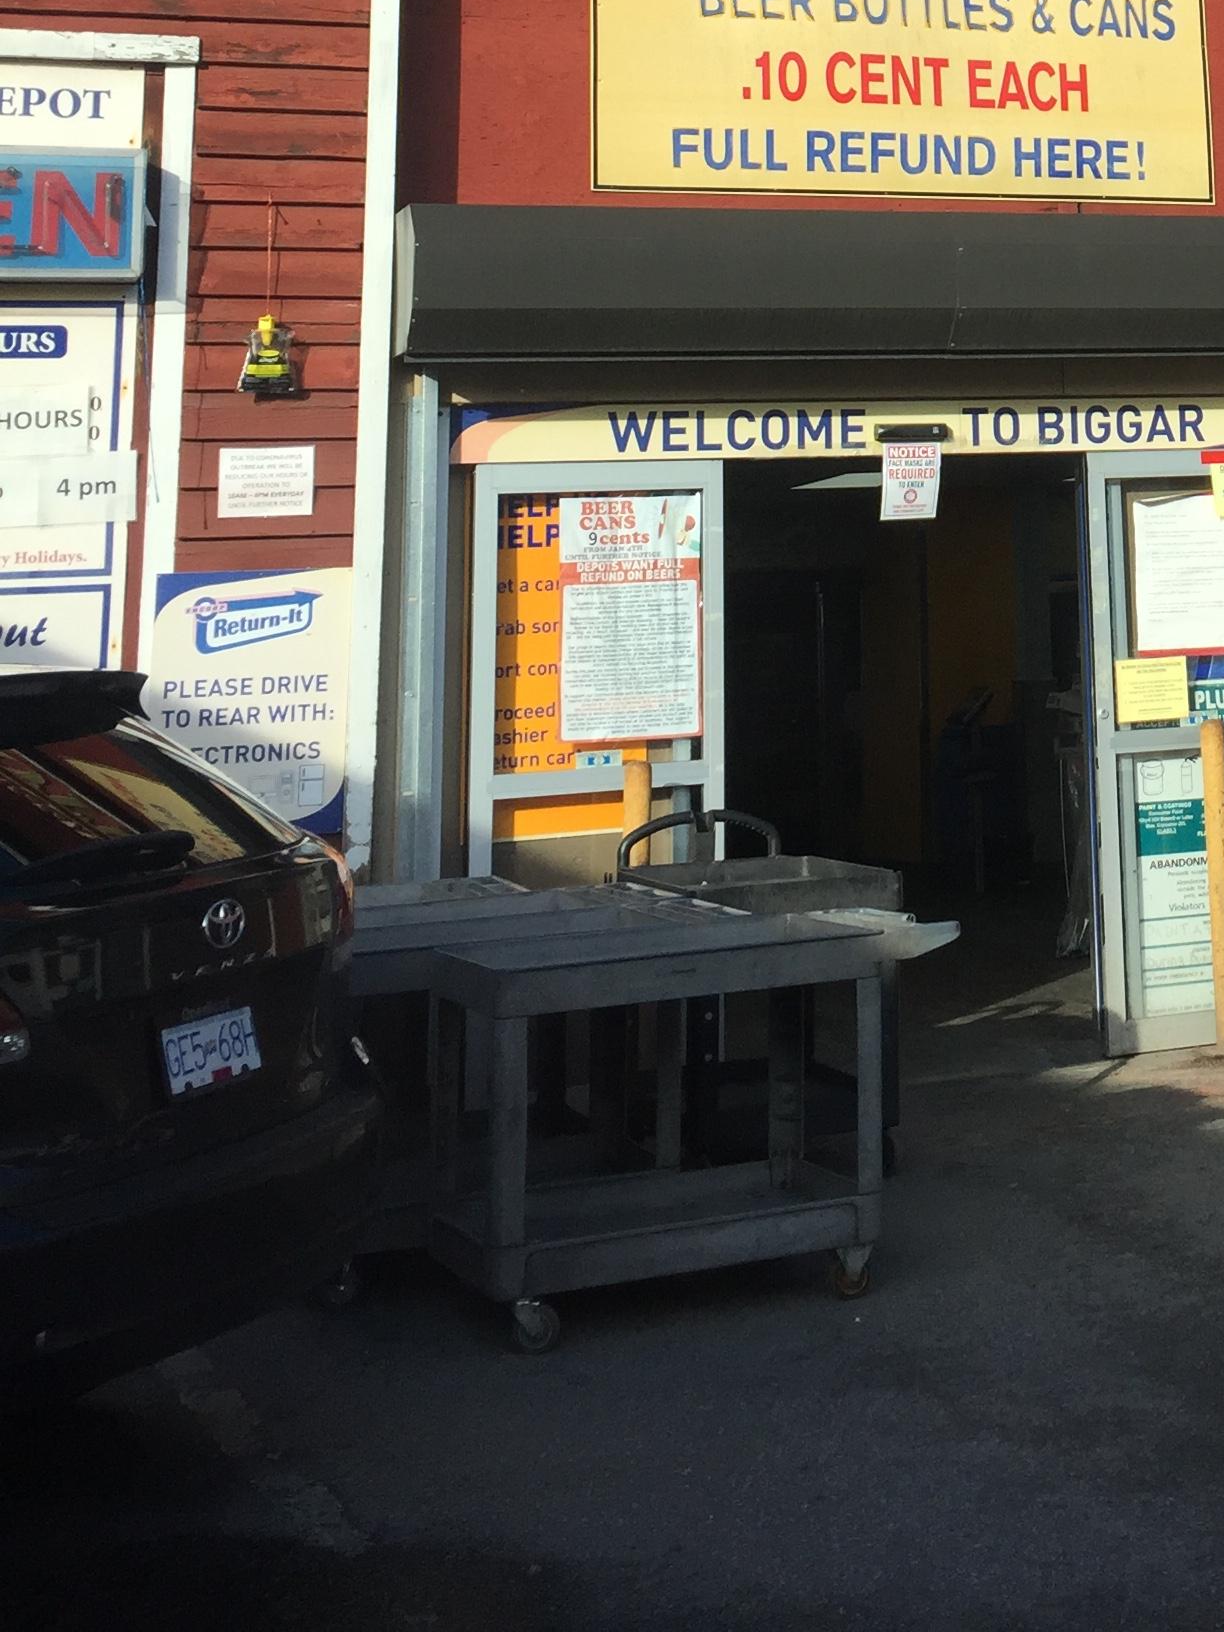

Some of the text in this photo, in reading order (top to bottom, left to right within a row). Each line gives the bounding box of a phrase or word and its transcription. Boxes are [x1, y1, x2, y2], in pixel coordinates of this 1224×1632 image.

[741, 51, 1090, 112] .10 CENT EACH
[671, 128, 1146, 181] FULL REFUND HERE!
[608, 404, 1206, 454] WELCOME TO BIGGAR
[889, 447, 936, 458] NOTICE
[888, 468, 936, 480] REQUIRED
[56, 478, 117, 500] 4 pm
[580, 500, 634, 515] BEER
[579, 515, 636, 530] CANS
[588, 532, 650, 545] 9 cents
[14, 549, 88, 566] Holidays.
[576, 558, 684, 572] DEPOTS WANT FULL
[580, 571, 625, 583] REFUND
[627, 570, 643, 581] ON
[213, 608, 303, 638] Return-It
[163, 674, 329, 699] PLEASE DRIVE
[161, 703, 335, 728] TO REAR WITH:
